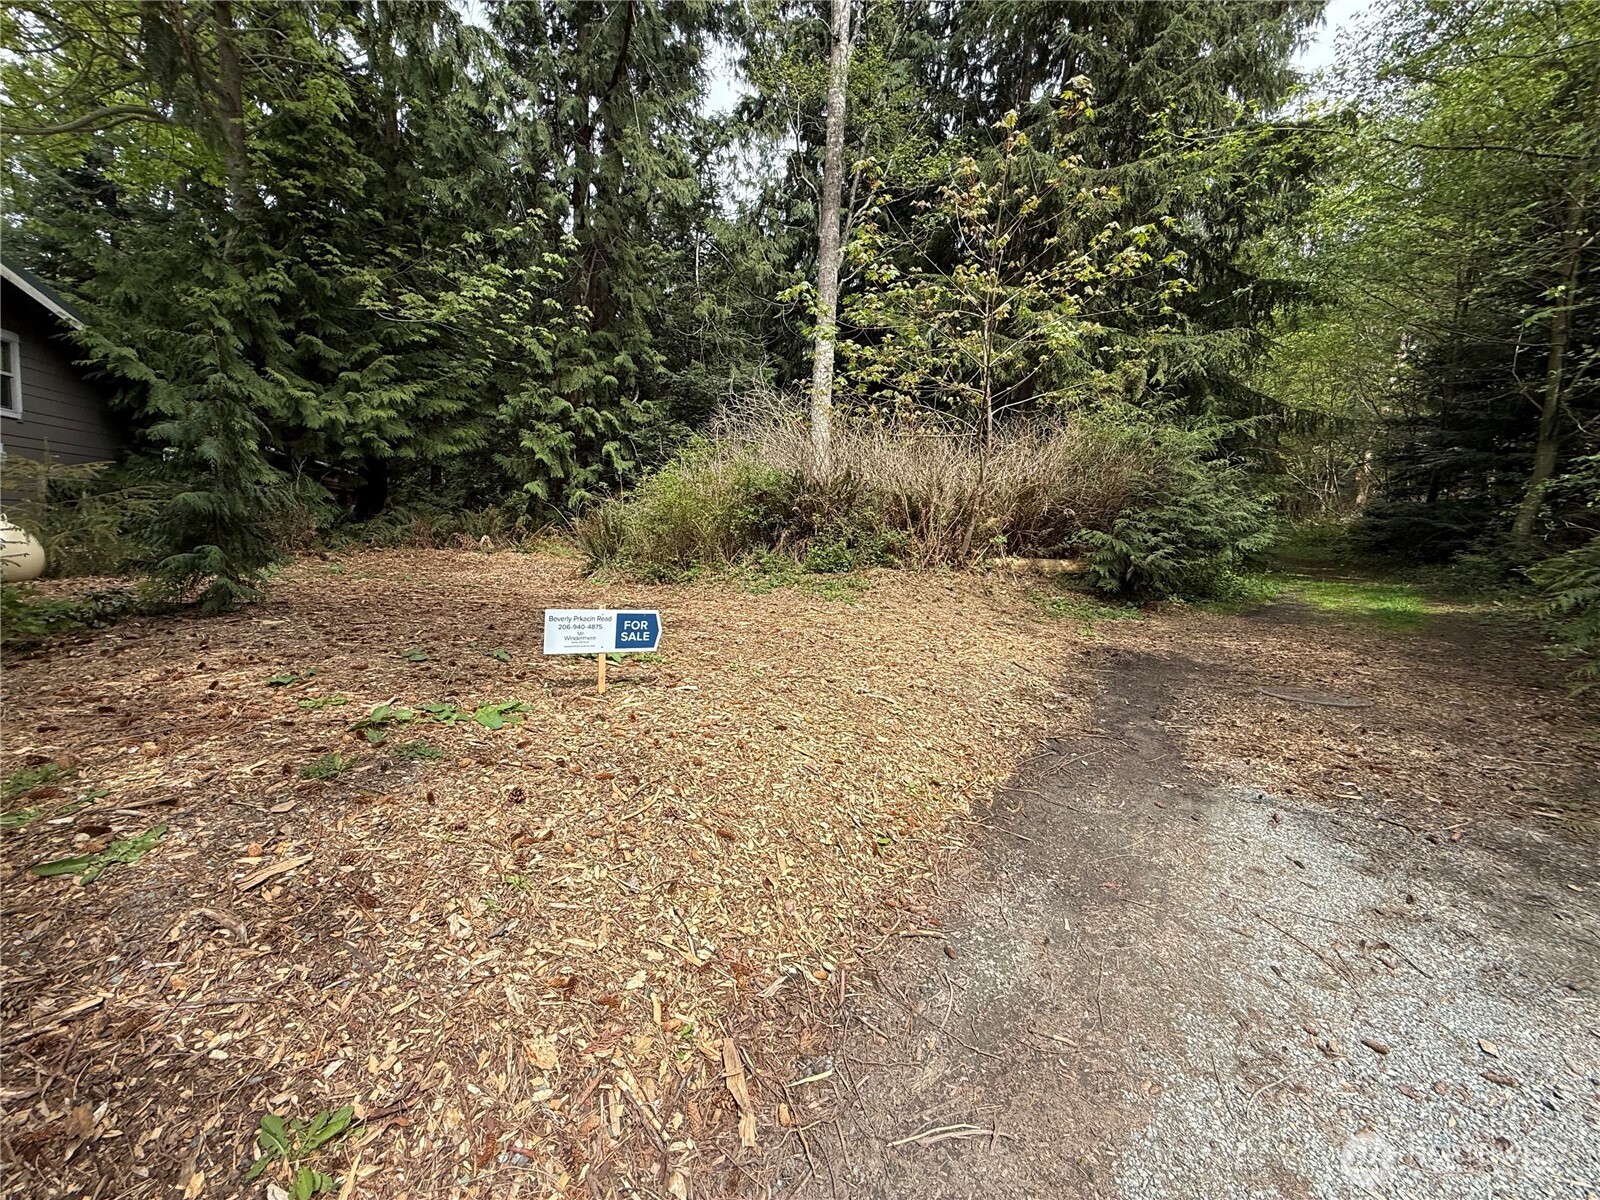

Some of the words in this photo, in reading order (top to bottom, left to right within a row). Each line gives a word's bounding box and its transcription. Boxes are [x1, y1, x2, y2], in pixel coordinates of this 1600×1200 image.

[549, 615, 573, 623] Beverly
[624, 620, 648, 630] FOR
[620, 632, 650, 641] SALE
